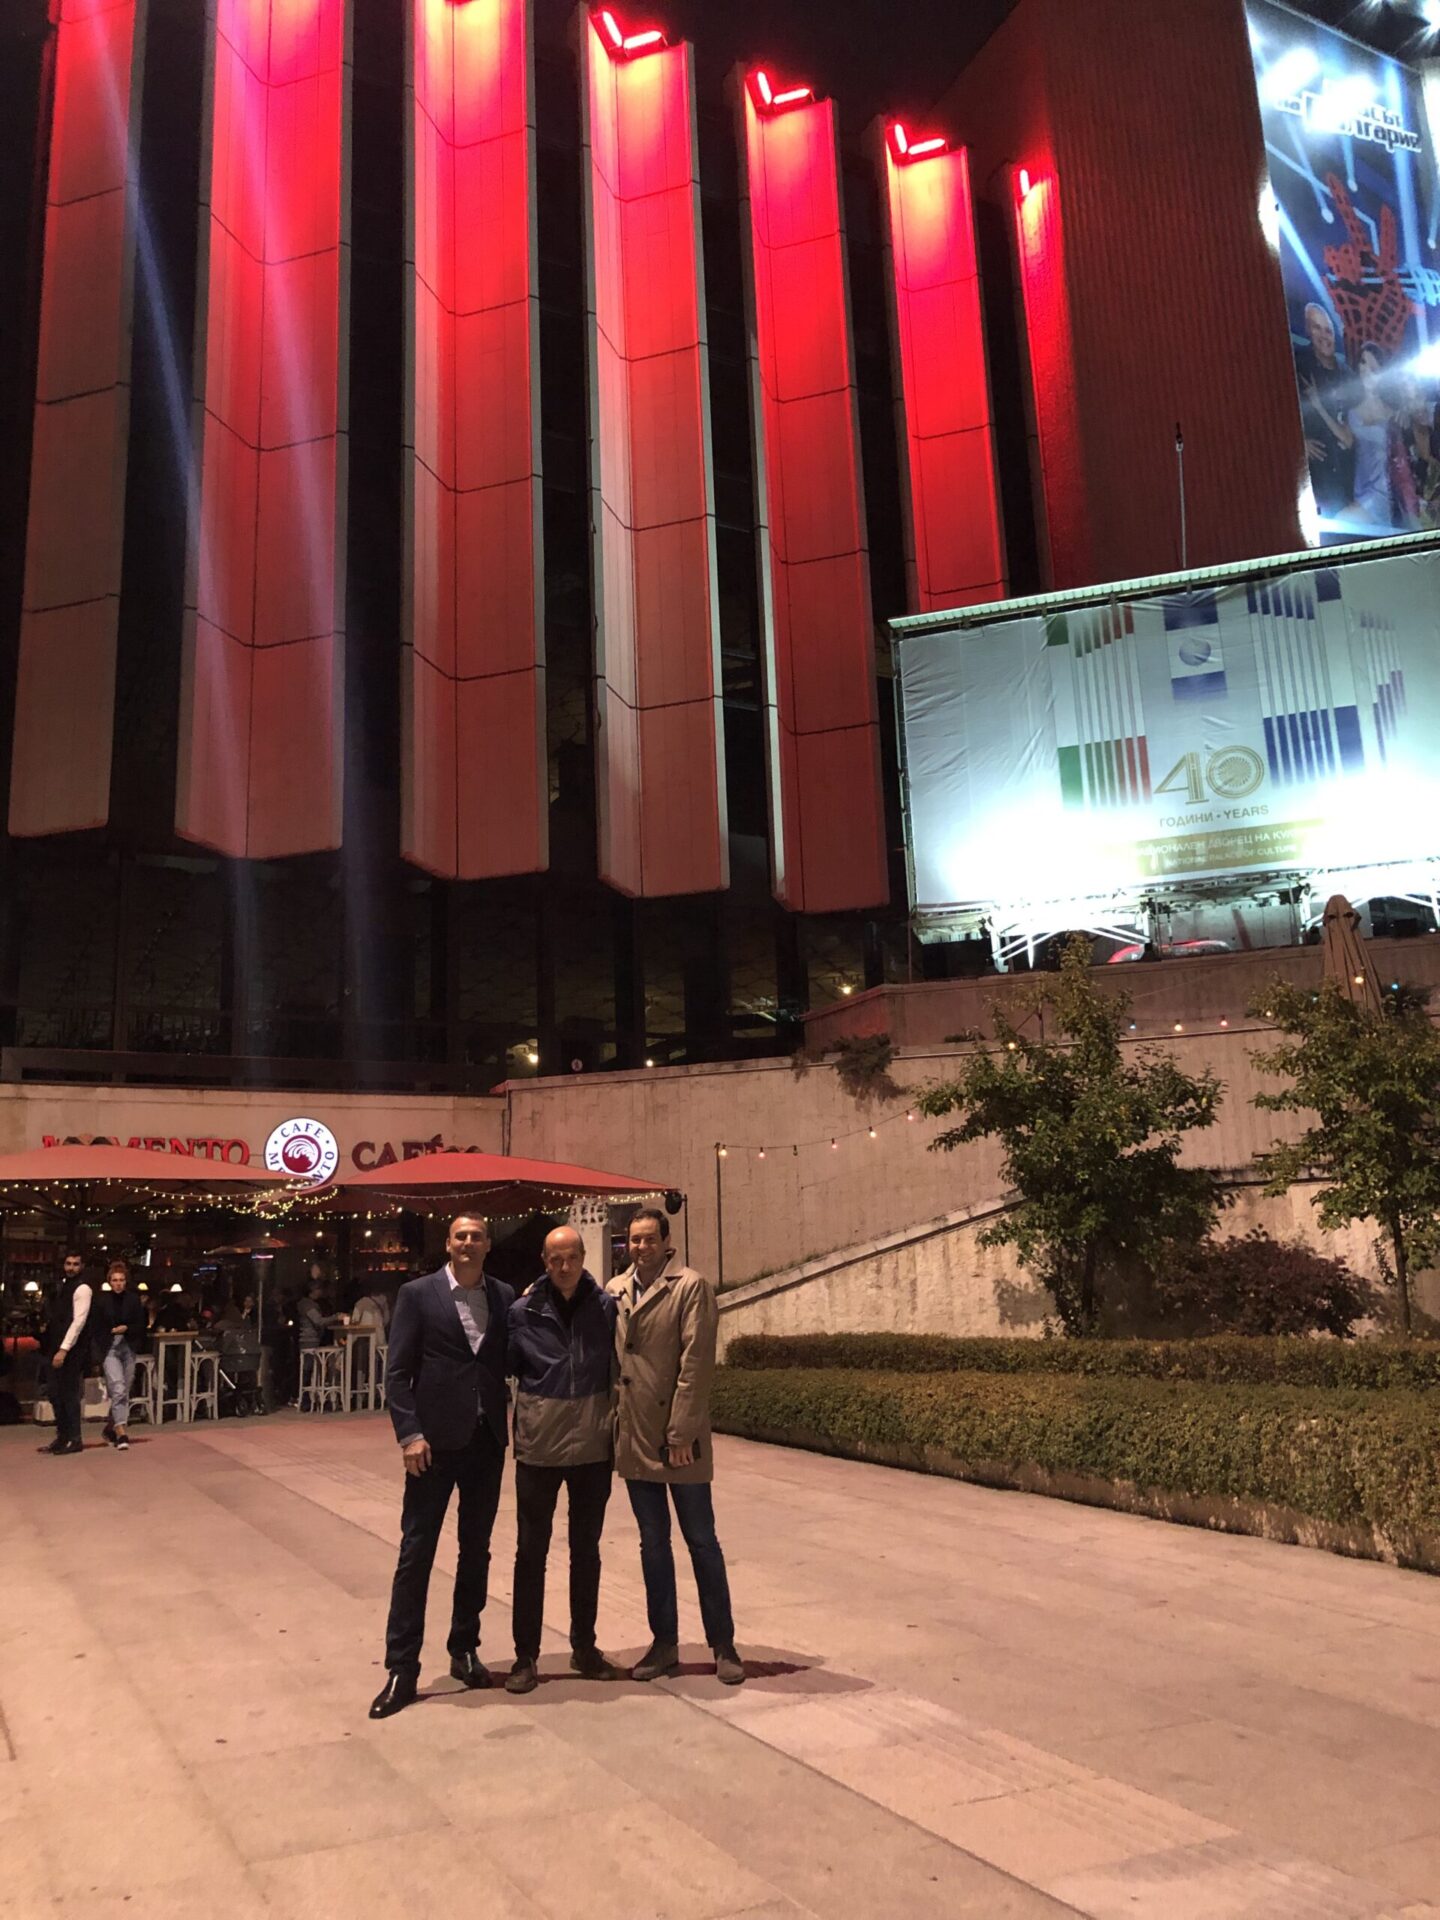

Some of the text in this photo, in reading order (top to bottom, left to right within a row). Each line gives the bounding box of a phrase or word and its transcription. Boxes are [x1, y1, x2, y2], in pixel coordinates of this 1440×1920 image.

[1159, 804, 1269, 828] ГОДИНИ YEARS
[1254, 832, 1270, 842] НА
[280, 1122, 324, 1139] CAFE
